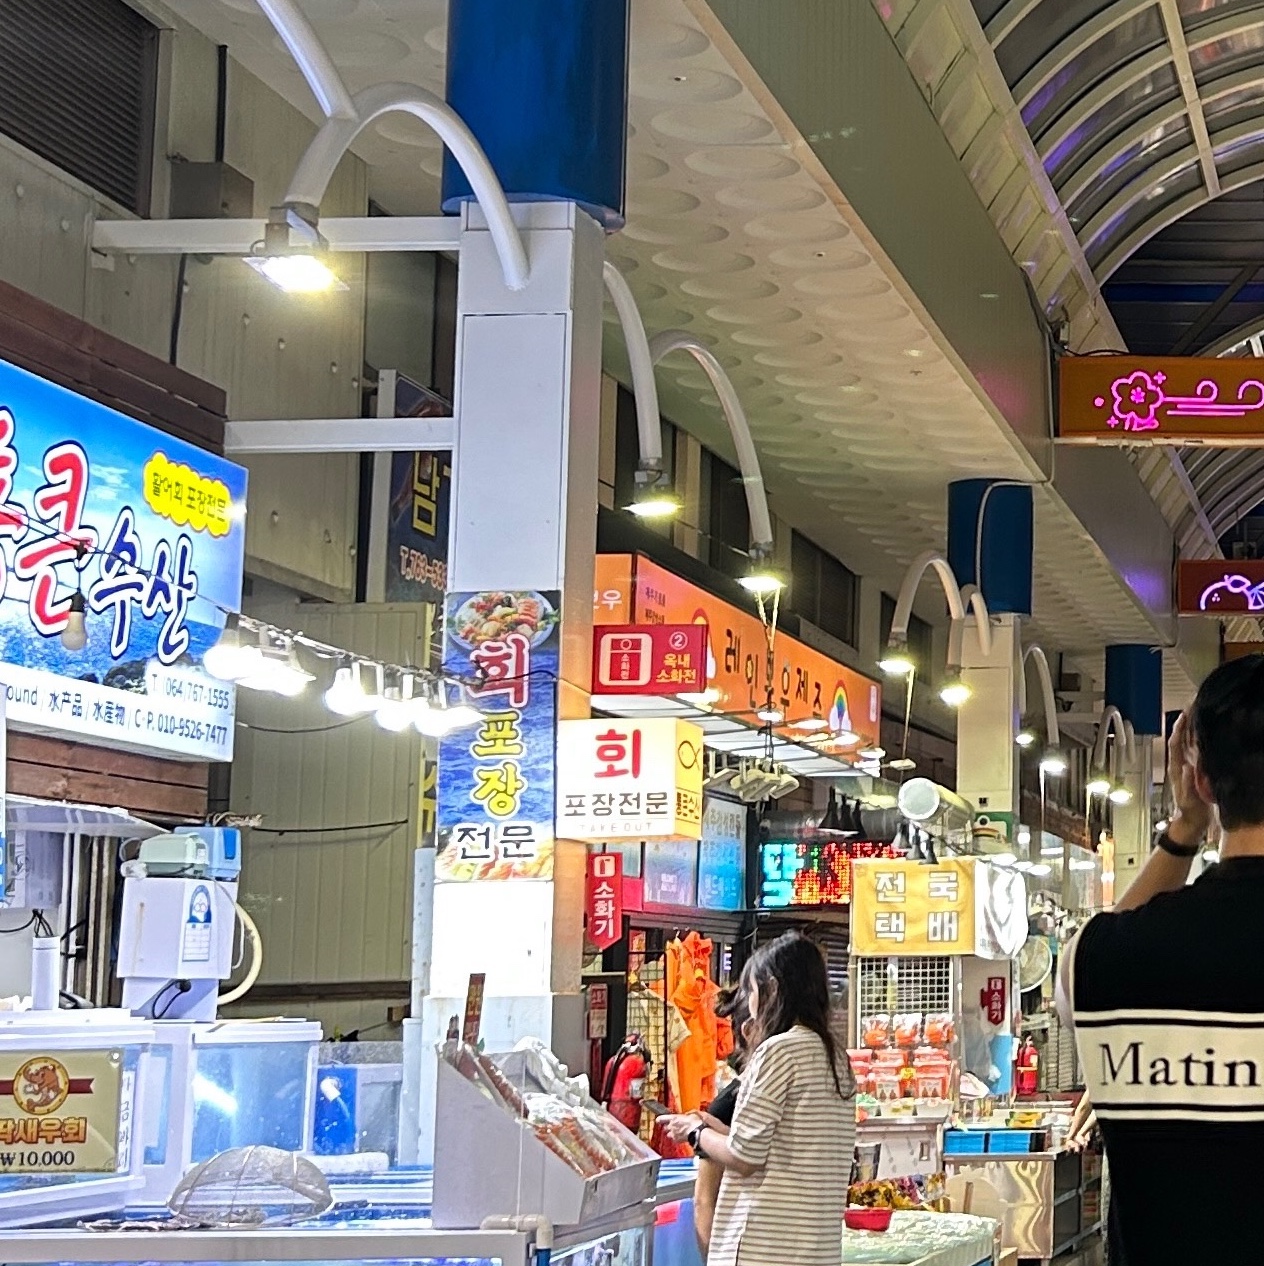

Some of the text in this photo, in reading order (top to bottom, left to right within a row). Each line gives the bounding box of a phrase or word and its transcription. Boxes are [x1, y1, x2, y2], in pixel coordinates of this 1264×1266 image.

[466, 633, 530, 708] 회
[656, 669, 696, 684] 소화전
[664, 653, 691, 668] 옥내
[48, 690, 82, 717] 水产品
[93, 701, 125, 727] 水産物
[157, 718, 228, 746] 010-9526-7477
[470, 709, 527, 819] 포장
[594, 728, 642, 779] 회
[564, 791, 669, 817] 포장전문
[457, 824, 536, 861] 전문
[875, 871, 959, 904] 전국
[593, 881, 616, 939] 소화기
[875, 911, 959, 943] 택배
[1100, 1041, 1261, 1088] Matin
